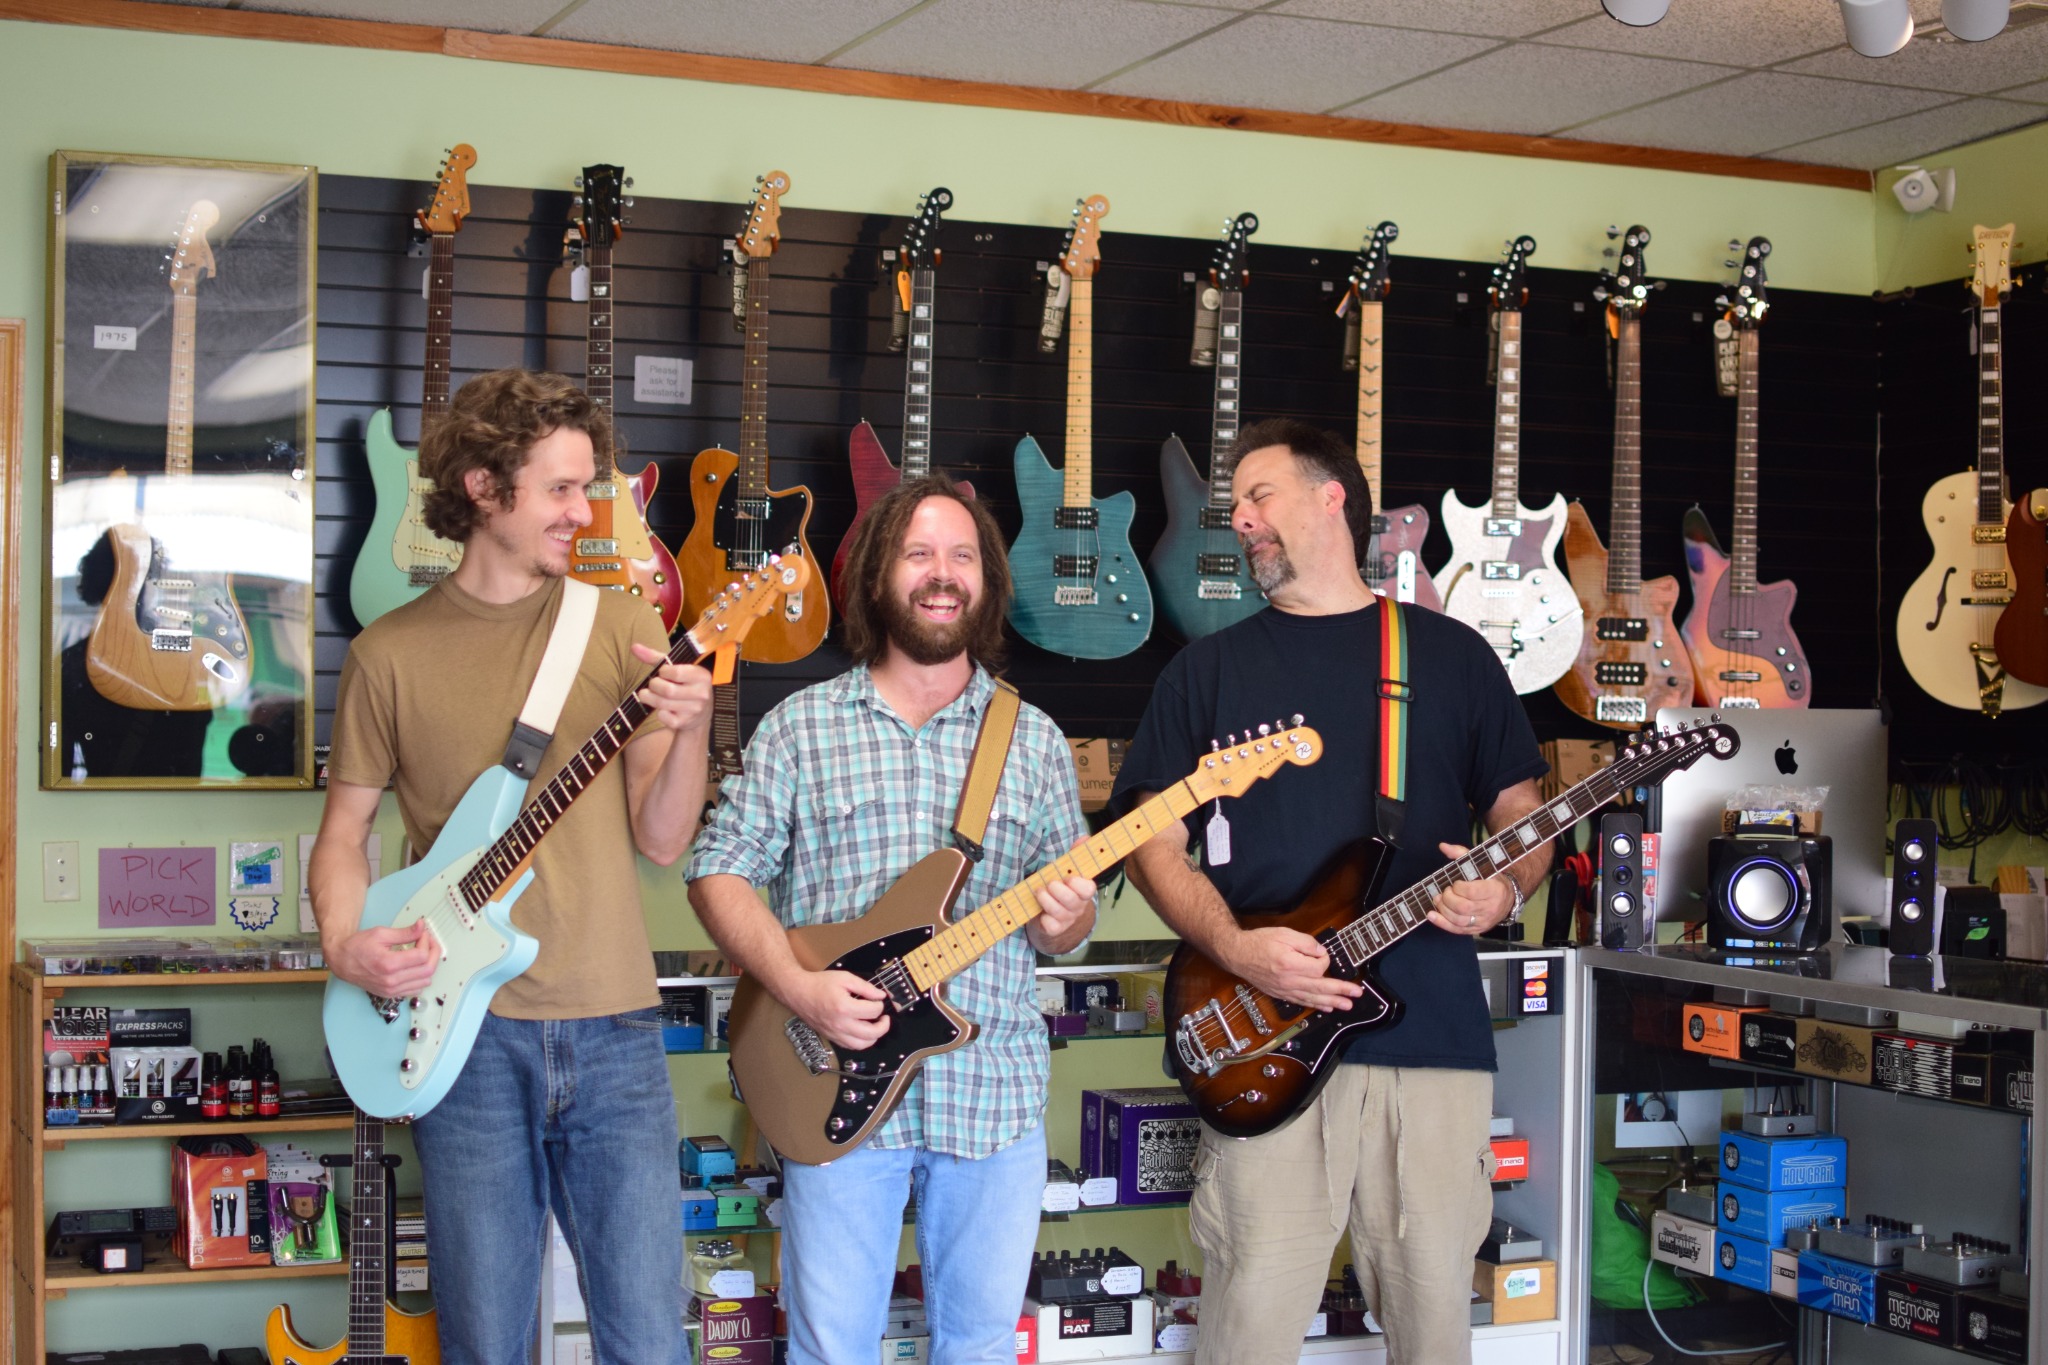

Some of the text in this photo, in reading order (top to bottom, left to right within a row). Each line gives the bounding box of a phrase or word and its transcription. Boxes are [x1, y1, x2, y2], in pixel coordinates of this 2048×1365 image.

[100, 332, 127, 341] 1975
[649, 365, 678, 375] Please
[666, 378, 678, 386] for
[641, 388, 685, 398] assistance
[1078, 779, 1114, 789] umen
[120, 856, 203, 885] PICK
[108, 890, 210, 919] WORLD
[1526, 1000, 1546, 1009] VISA
[51, 1019, 107, 1036] VOICE
[1964, 1077, 1980, 1085] nano
[1144, 1147, 1188, 1168] Cathedral
[267, 1168, 288, 1178] String
[1781, 1166, 1806, 1186] HOLY
[194, 1234, 204, 1264] Data
[1780, 1268, 1795, 1278] nano
[1822, 1275, 1863, 1296] MEMORY
[1833, 1292, 1860, 1313] MAN
[1888, 1297, 1940, 1325] MEMORY
[1889, 1313, 1911, 1331] BOY
[707, 1319, 740, 1341] DADDY
[1063, 1324, 1091, 1335] RAT
[898, 1345, 915, 1354] SM7
